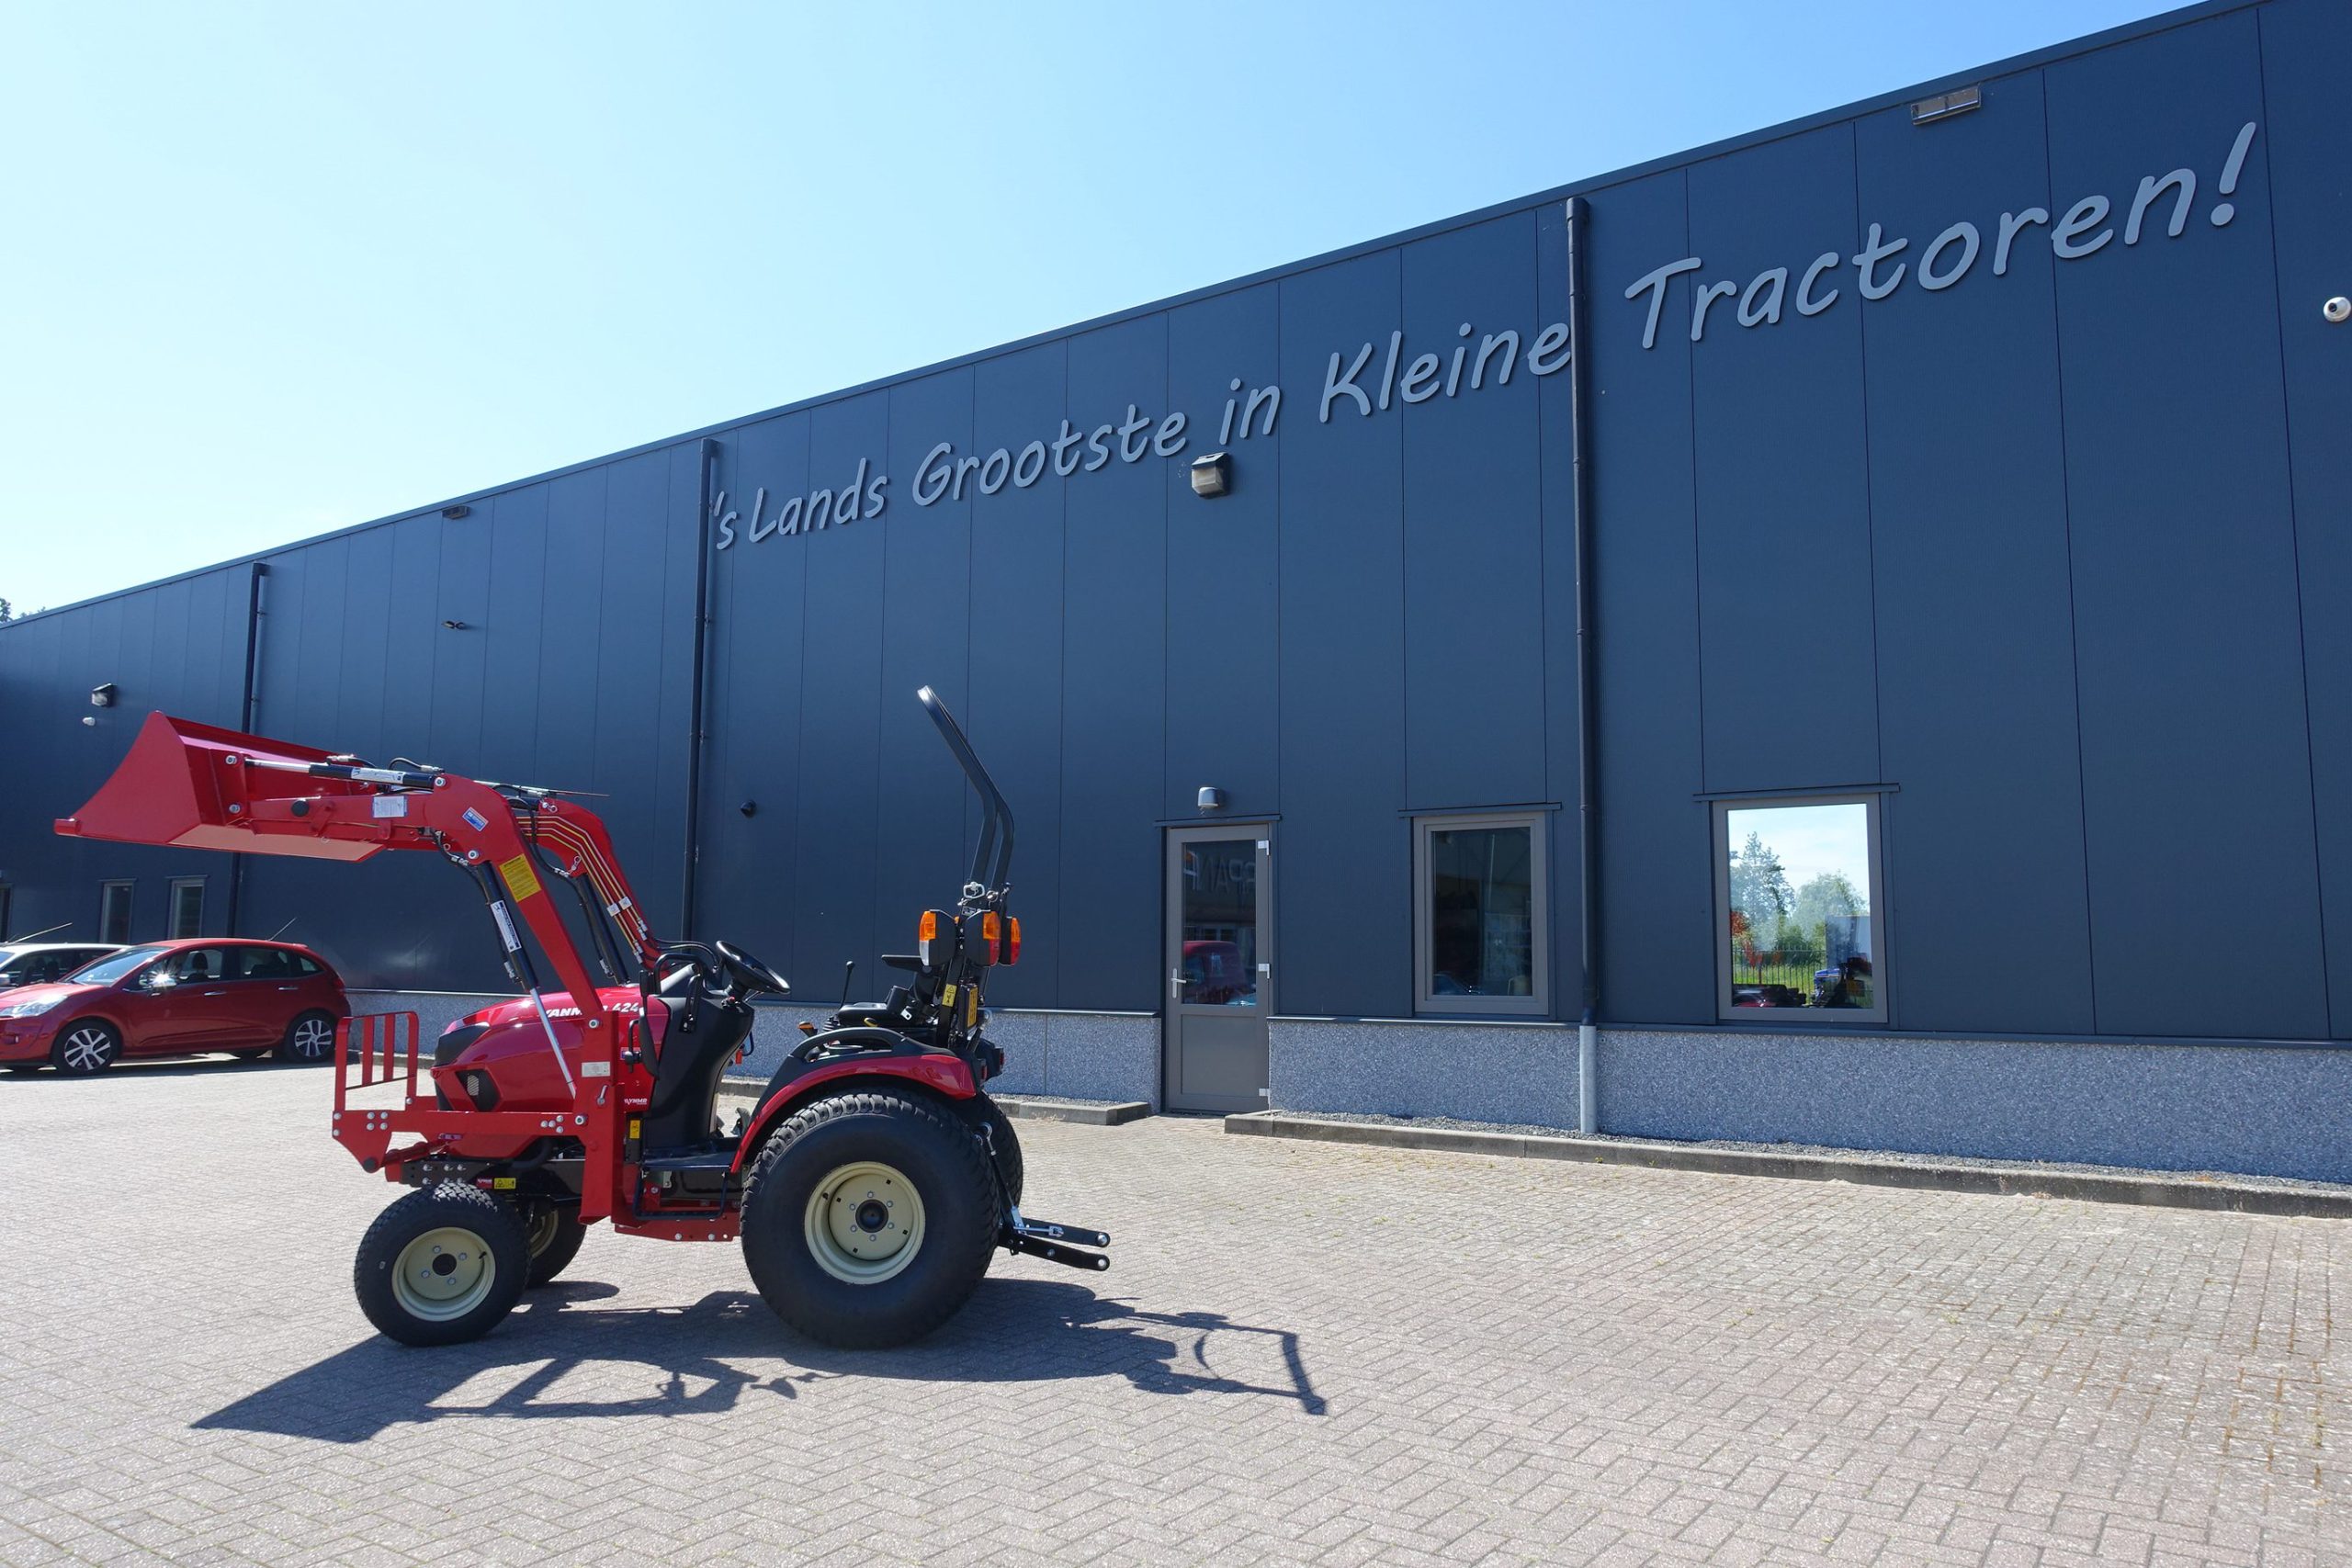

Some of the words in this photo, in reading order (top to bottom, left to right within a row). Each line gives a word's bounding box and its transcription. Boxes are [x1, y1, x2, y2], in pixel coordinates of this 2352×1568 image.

[713, 491, 738, 550] 's
[748, 457, 888, 543] Lands
[911, 403, 1187, 507] Grootste
[1218, 378, 1282, 446] in
[1318, 321, 1572, 423] Kleine
[1624, 120, 2257, 350] Tractoren!
[612, 1002, 639, 1013] 424
